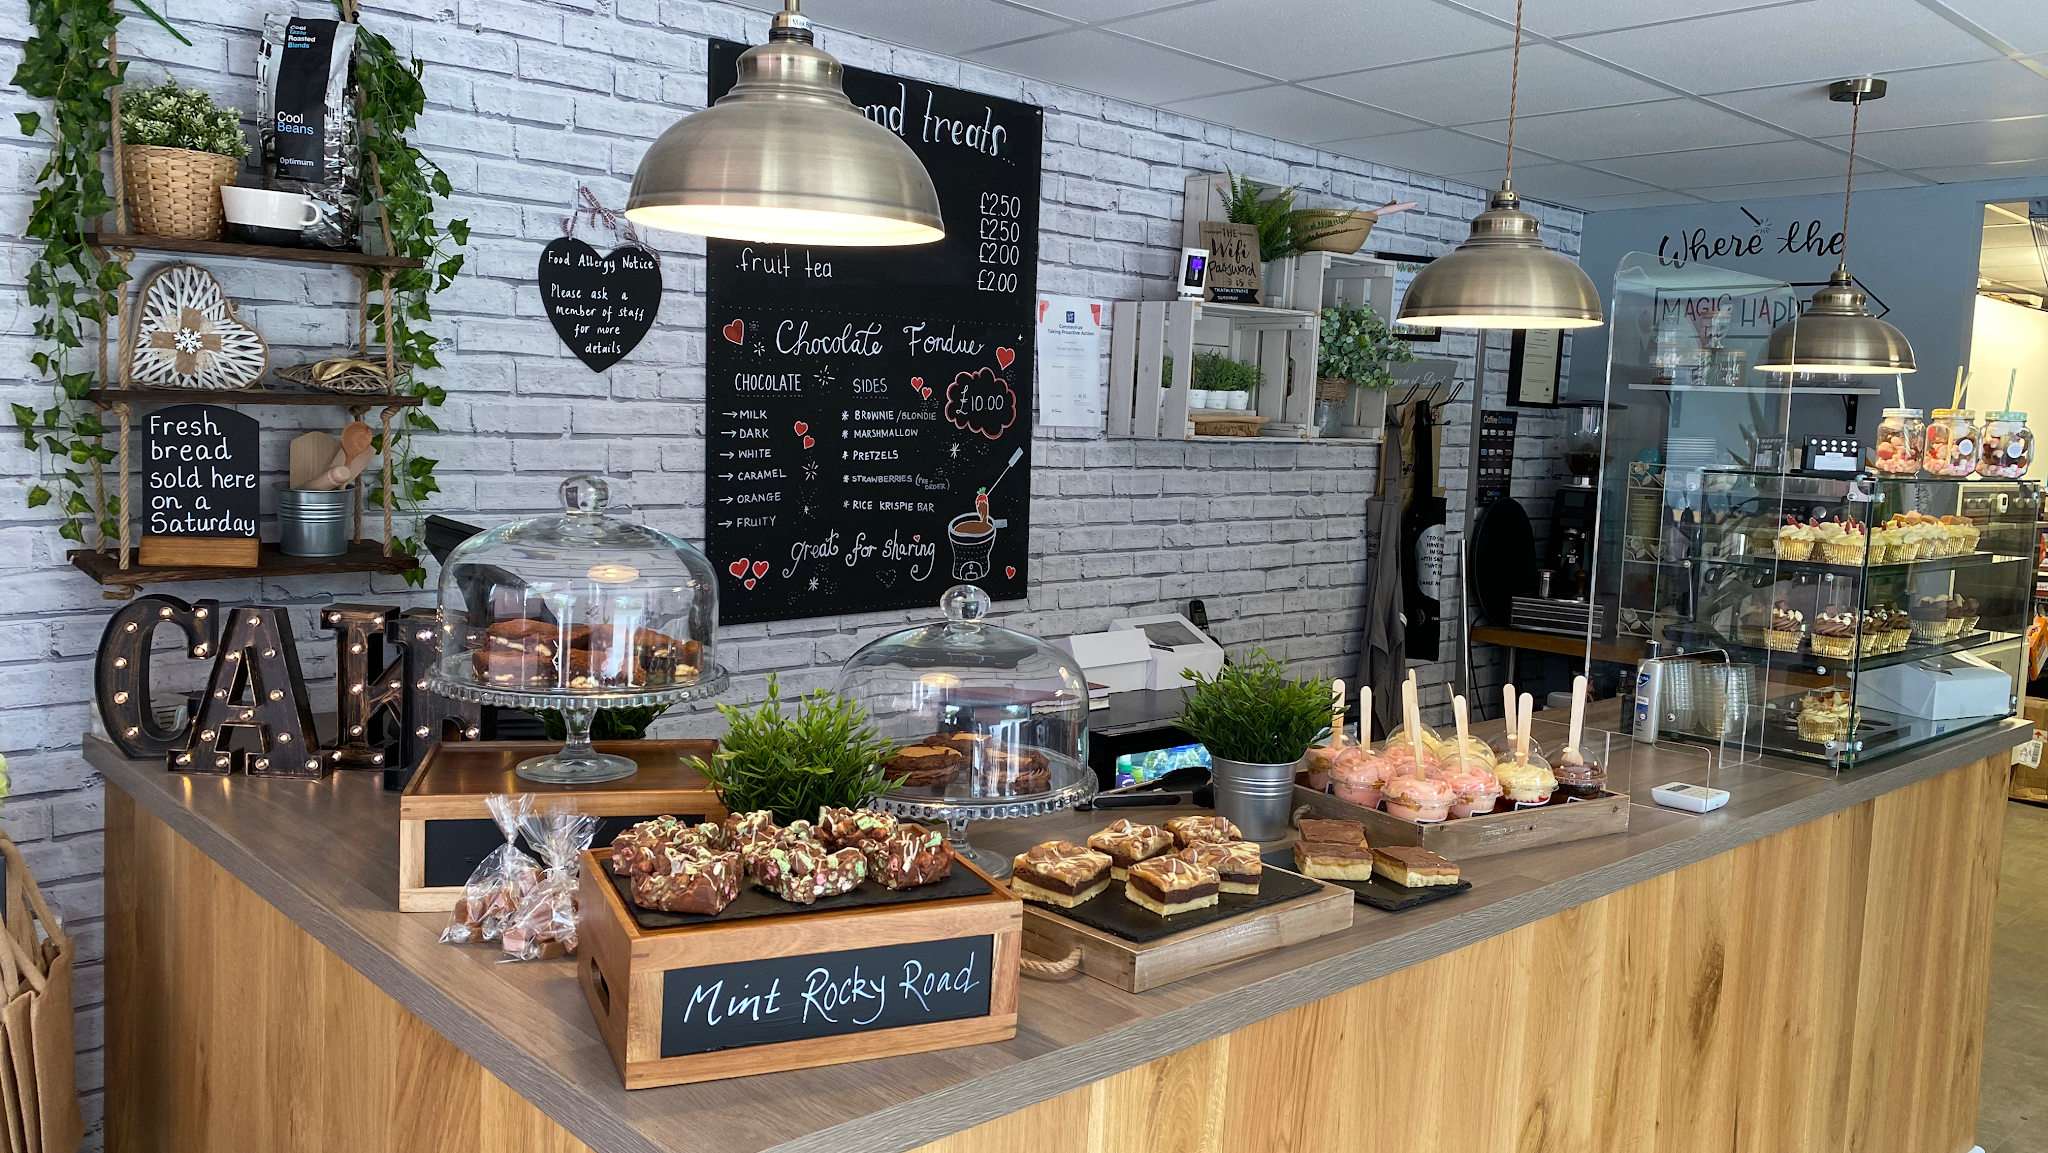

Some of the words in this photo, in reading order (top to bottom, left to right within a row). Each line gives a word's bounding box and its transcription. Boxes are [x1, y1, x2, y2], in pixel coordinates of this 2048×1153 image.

[288, 35, 316, 43] Roasted
[277, 111, 304, 124] Cool
[277, 122, 314, 136] Beans
[279, 156, 314, 167] Optimum
[1222, 228, 1238, 238] THE
[1211, 237, 1251, 264] Wifi
[1658, 228, 1764, 269] Where
[1777, 219, 1847, 257] the
[548, 250, 571, 266] Food
[577, 253, 616, 275] Allergy
[622, 254, 654, 270] Notice
[741, 247, 791, 279] fruit
[804, 249, 834, 280] tea
[1235, 277, 1244, 288] is
[551, 282, 582, 298] Please
[590, 286, 609, 301] ask
[621, 292, 629, 301] a
[602, 305, 613, 323] of
[618, 306, 645, 322] staff
[1661, 292, 1733, 328] MAGIC
[574, 323, 590, 338] for
[597, 325, 621, 335] more
[1047, 328, 1061, 336] Taking
[1058, 323, 1083, 331] Coronavirus
[775, 319, 884, 357] Chocolate
[903, 321, 986, 357] Fondue
[584, 340, 621, 354] details
[735, 373, 802, 392] CHOCOLATE
[853, 378, 888, 393] SIDES
[955, 384, 1004, 415] £10.00
[739, 409, 768, 420] MILK
[854, 410, 894, 421] BROWNIE
[1483, 415, 1498, 424] Coffee
[150, 410, 221, 436] Fresh
[739, 428, 770, 439] DARK
[853, 428, 919, 439] MARSHMALLOW
[151, 436, 233, 461] bread
[738, 448, 772, 459] WHITE
[852, 449, 899, 461] PRETZELS
[150, 465, 203, 489] sold
[211, 465, 256, 489] here
[737, 468, 787, 481] CARAMEL
[851, 474, 913, 484] STRAWBERRIES
[151, 495, 182, 510] on
[195, 495, 211, 510] a
[736, 491, 782, 504] ORANGE
[852, 500, 873, 510] RICE
[879, 501, 914, 512] KRISPIE
[916, 501, 935, 513] BAR
[151, 509, 255, 537] Saturday
[736, 515, 777, 528] FRUITY
[782, 528, 839, 578] great
[845, 532, 877, 567] for
[683, 978, 781, 1026] Mint
[800, 965, 886, 1025] Rocky
[898, 951, 980, 1012] Road
